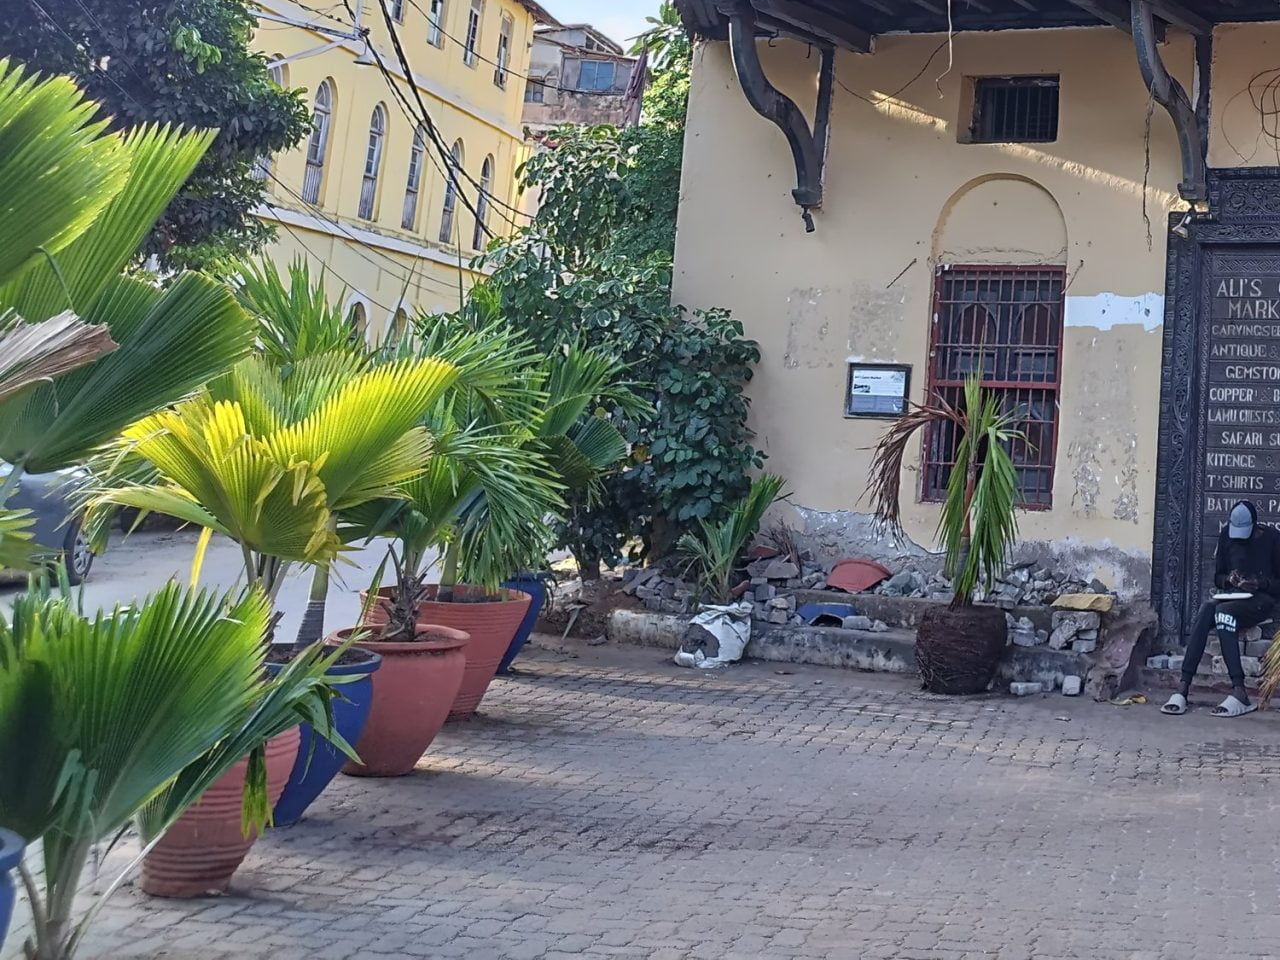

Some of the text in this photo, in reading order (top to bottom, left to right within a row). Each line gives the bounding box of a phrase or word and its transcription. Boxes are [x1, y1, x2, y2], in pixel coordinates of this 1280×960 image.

[1216, 279, 1262, 297] ALI'S
[1211, 325, 1271, 337] CARVINGS
[1210, 344, 1267, 358] ANTIQUE
[1207, 408, 1237, 422] LAMU
[1221, 431, 1263, 446] SAFARI
[1206, 452, 1256, 468] KITENGE
[1265, 455, 1275, 469] &
[1255, 499, 1265, 513] &
